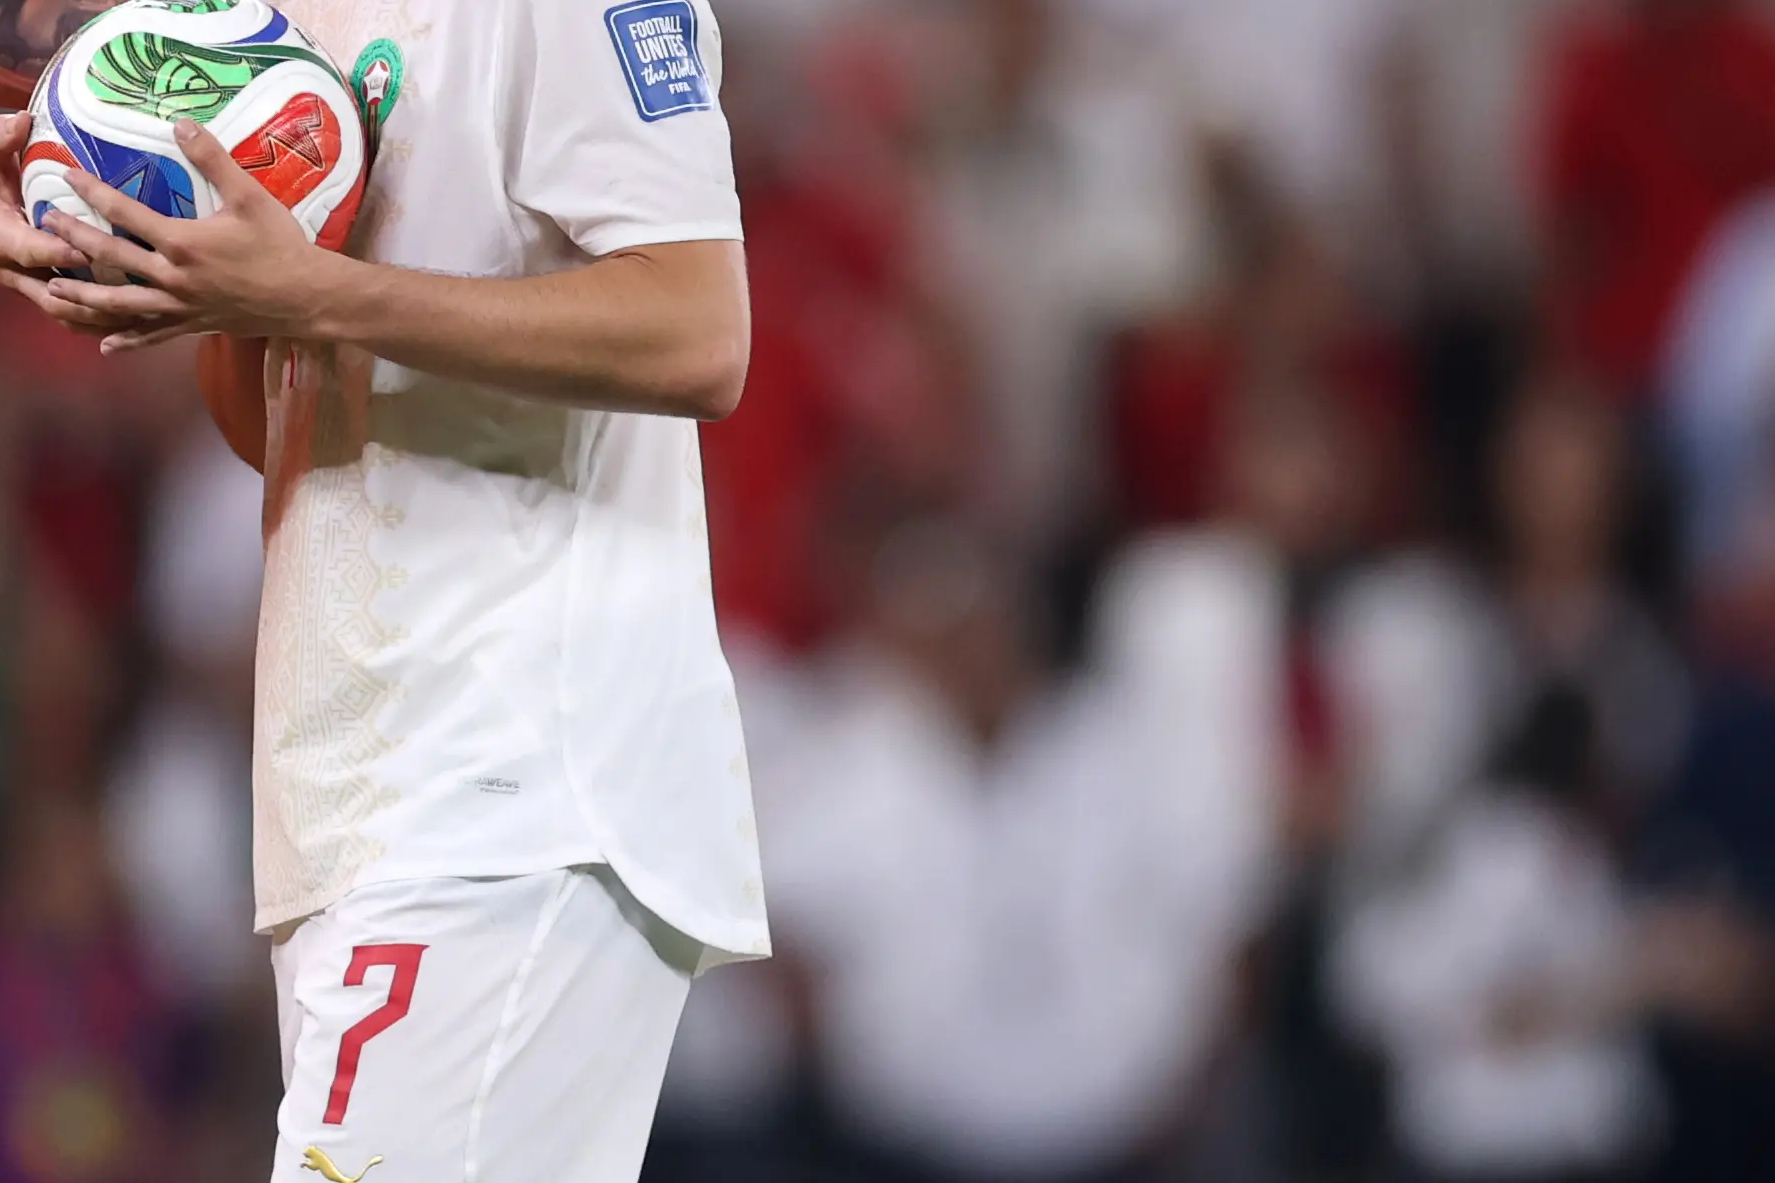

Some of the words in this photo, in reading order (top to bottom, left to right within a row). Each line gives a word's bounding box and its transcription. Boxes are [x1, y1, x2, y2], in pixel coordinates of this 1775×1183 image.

[628, 16, 683, 40] FOOTBALL
[634, 34, 688, 63] UNITES
[641, 64, 668, 86] the
[668, 82, 692, 95] FIFA
[322, 943, 430, 1125] 7
